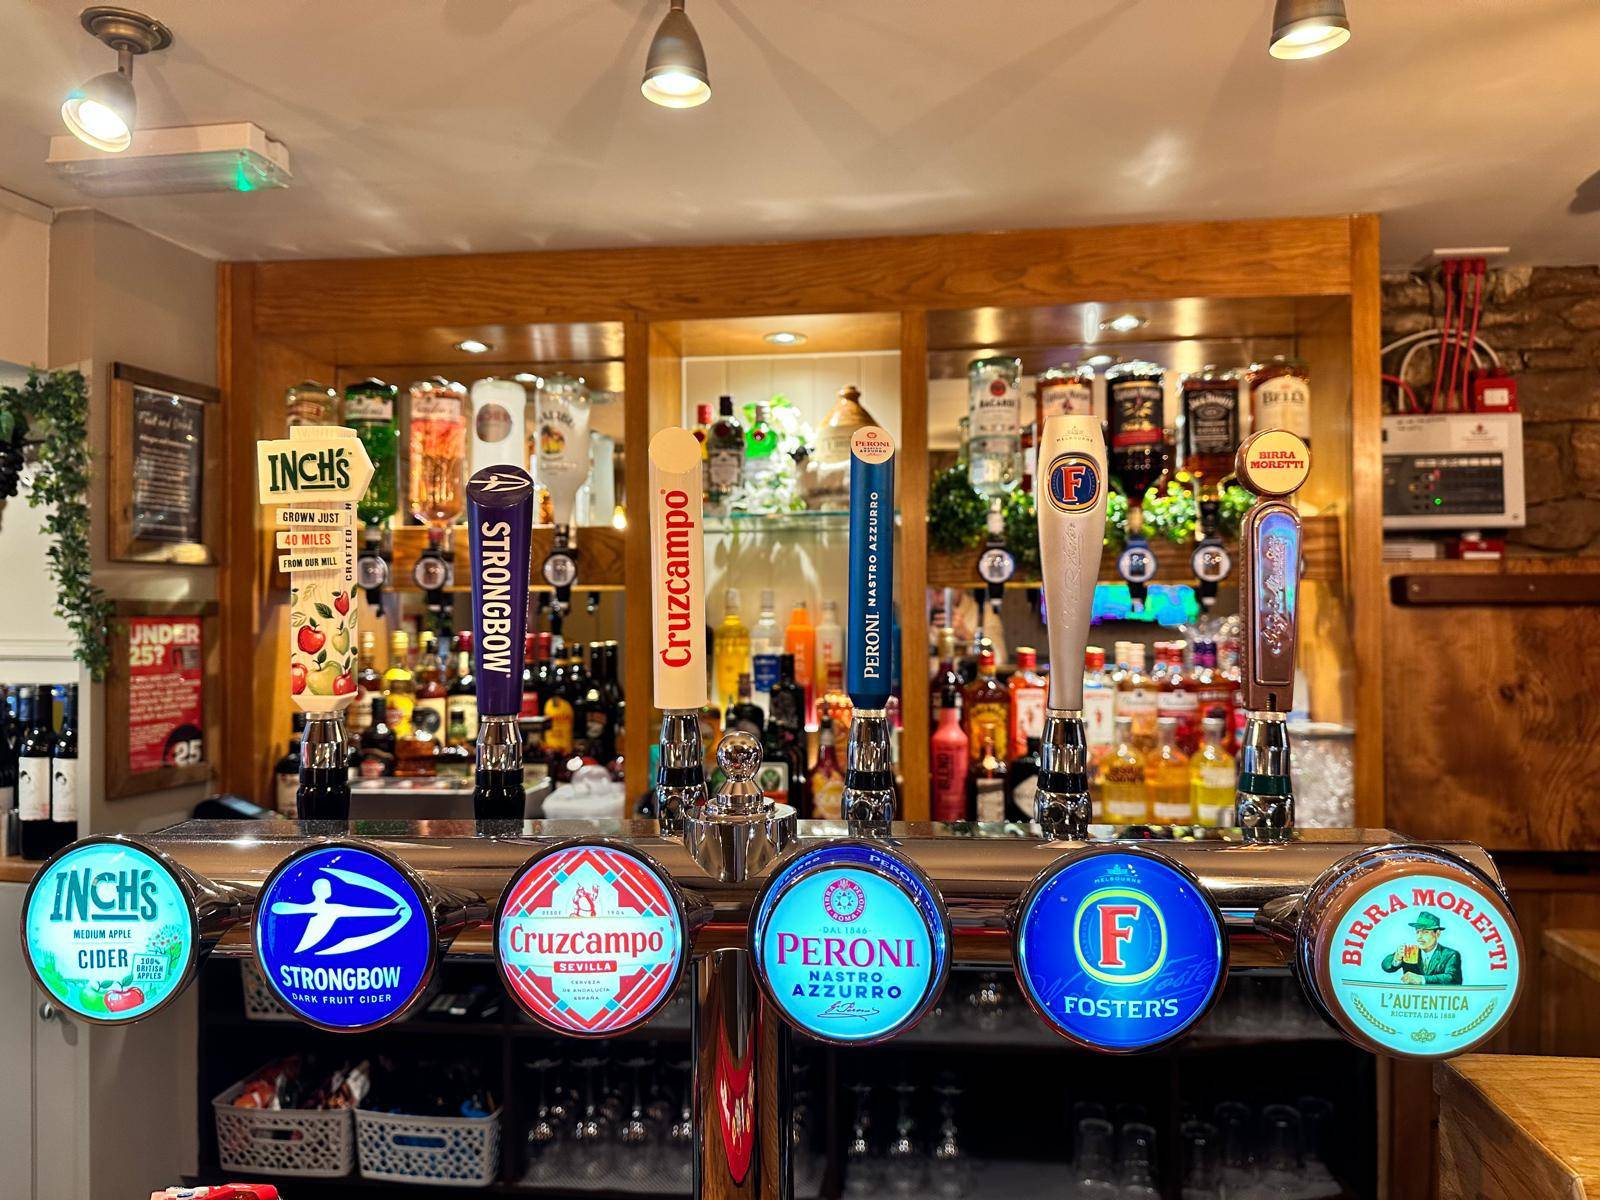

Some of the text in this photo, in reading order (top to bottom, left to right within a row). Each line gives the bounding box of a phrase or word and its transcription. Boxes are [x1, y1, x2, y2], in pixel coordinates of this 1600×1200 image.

[1259, 451, 1296, 460] BIRRA
[1250, 460, 1304, 469] MORETTI
[1061, 466, 1086, 501] F
[282, 512, 340, 523] GROWN JUST
[284, 534, 332, 546] 40 MILES
[283, 556, 338, 568] FROM OUR MILL
[660, 490, 695, 668] Cruzcampo
[864, 491, 880, 679] PERONI NASTRO AZZURRO
[481, 521, 512, 673] STRONGBOW
[174, 739, 202, 766] 25
[869, 854, 923, 897] PERONI
[824, 886, 865, 912] BIRRA PERONI
[833, 913, 857, 921] ROMA
[73, 929, 132, 940] MEDIUM APPLE
[823, 926, 868, 934] DAL 1846
[1097, 904, 1140, 968] F
[1341, 888, 1508, 971] BIRRA MORETTI
[510, 923, 664, 958] Cruzcampo
[777, 932, 917, 968] PERONI
[78, 948, 128, 970] CIDER
[559, 962, 612, 972] SEVILLA
[136, 964, 163, 972] BRITISH
[137, 972, 162, 980] APPLES
[809, 970, 883, 983] NASTRO
[280, 964, 401, 991] STRONGBOW
[292, 992, 392, 1004] DARK FRUIT CIDER
[792, 983, 902, 999] AZZURRO
[1064, 996, 1179, 1018] FOSTER'S
[1381, 993, 1469, 1011] L'AUTENTICA
[1391, 1010, 1422, 1019] RICETTA
